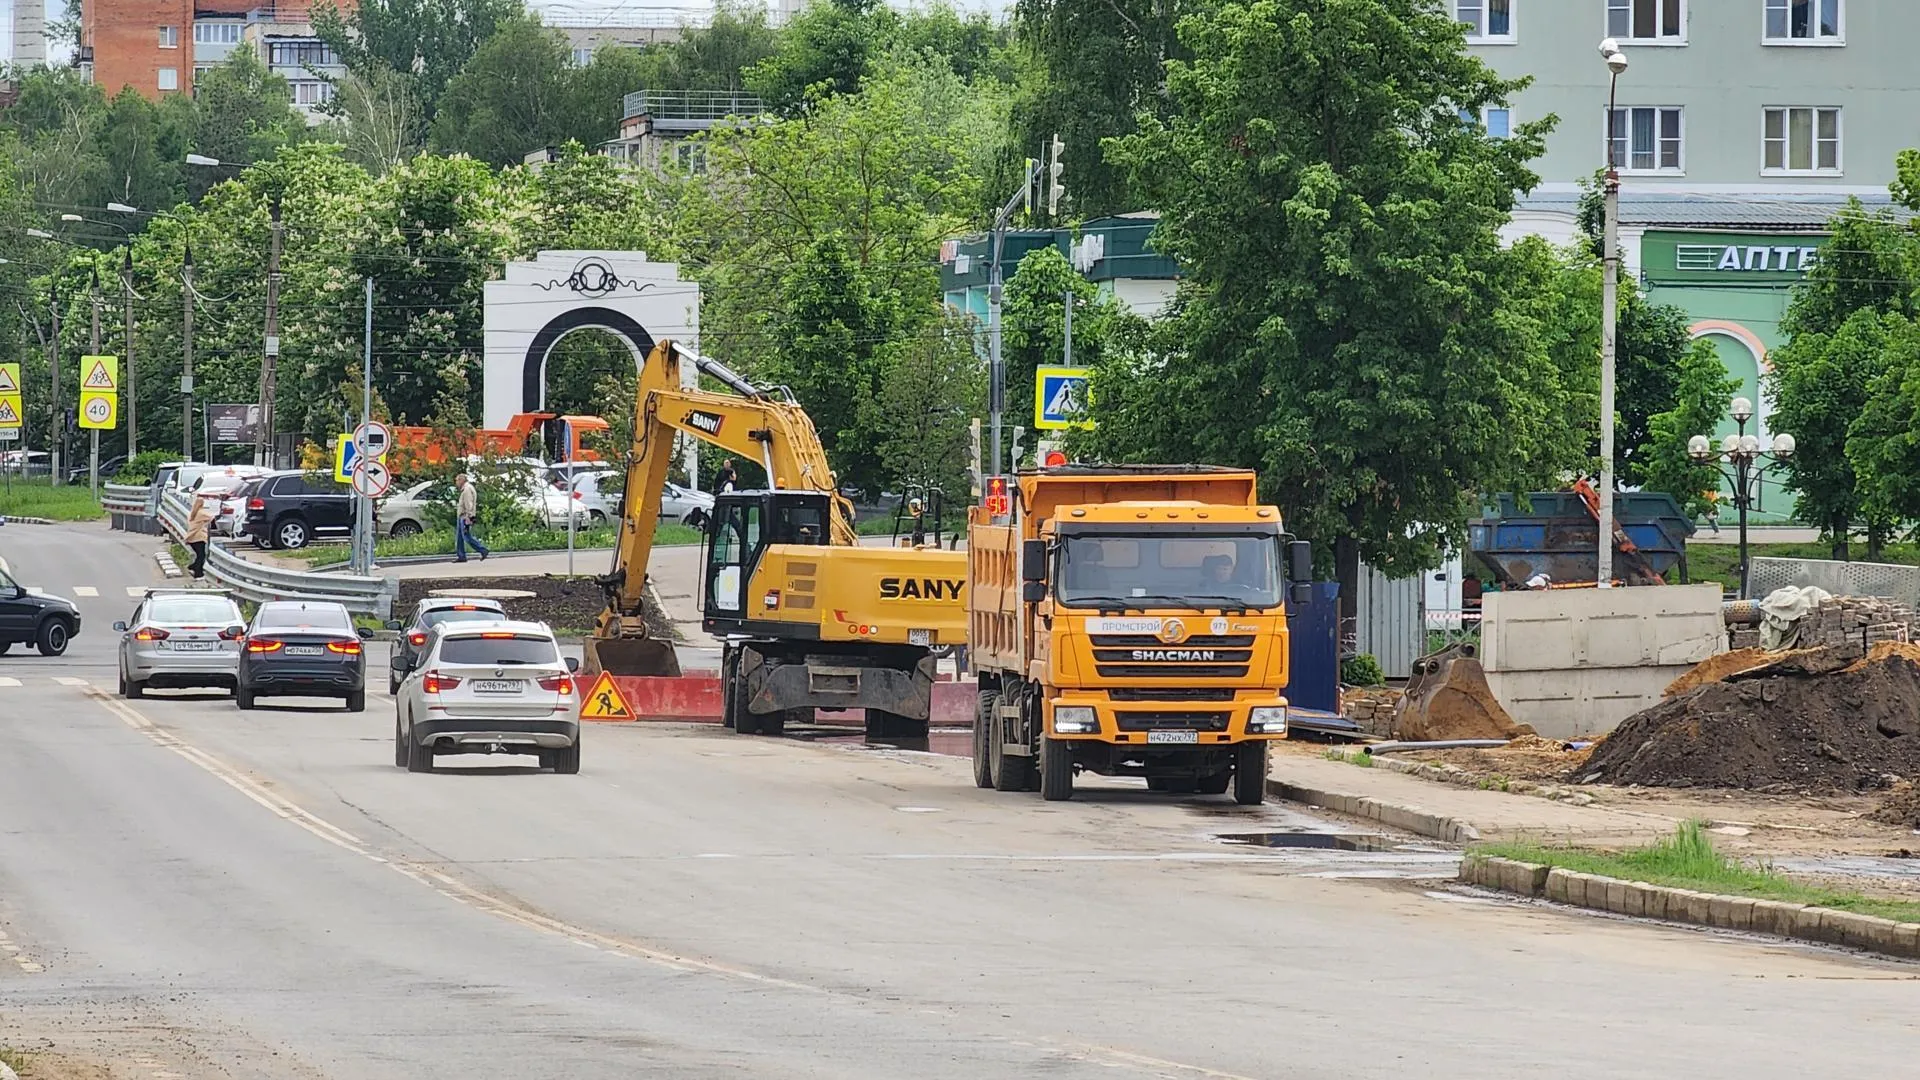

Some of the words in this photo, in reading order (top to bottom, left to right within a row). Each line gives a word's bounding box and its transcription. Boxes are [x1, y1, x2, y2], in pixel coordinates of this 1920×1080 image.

[1718, 246, 1820, 271] АПТЕ
[89, 404, 106, 416] 40
[692, 412, 717, 432] SANY
[880, 577, 967, 600] SANY
[1102, 621, 1160, 631] ПРОМСТРОЙ
[1132, 650, 1215, 661] SHACMAN
